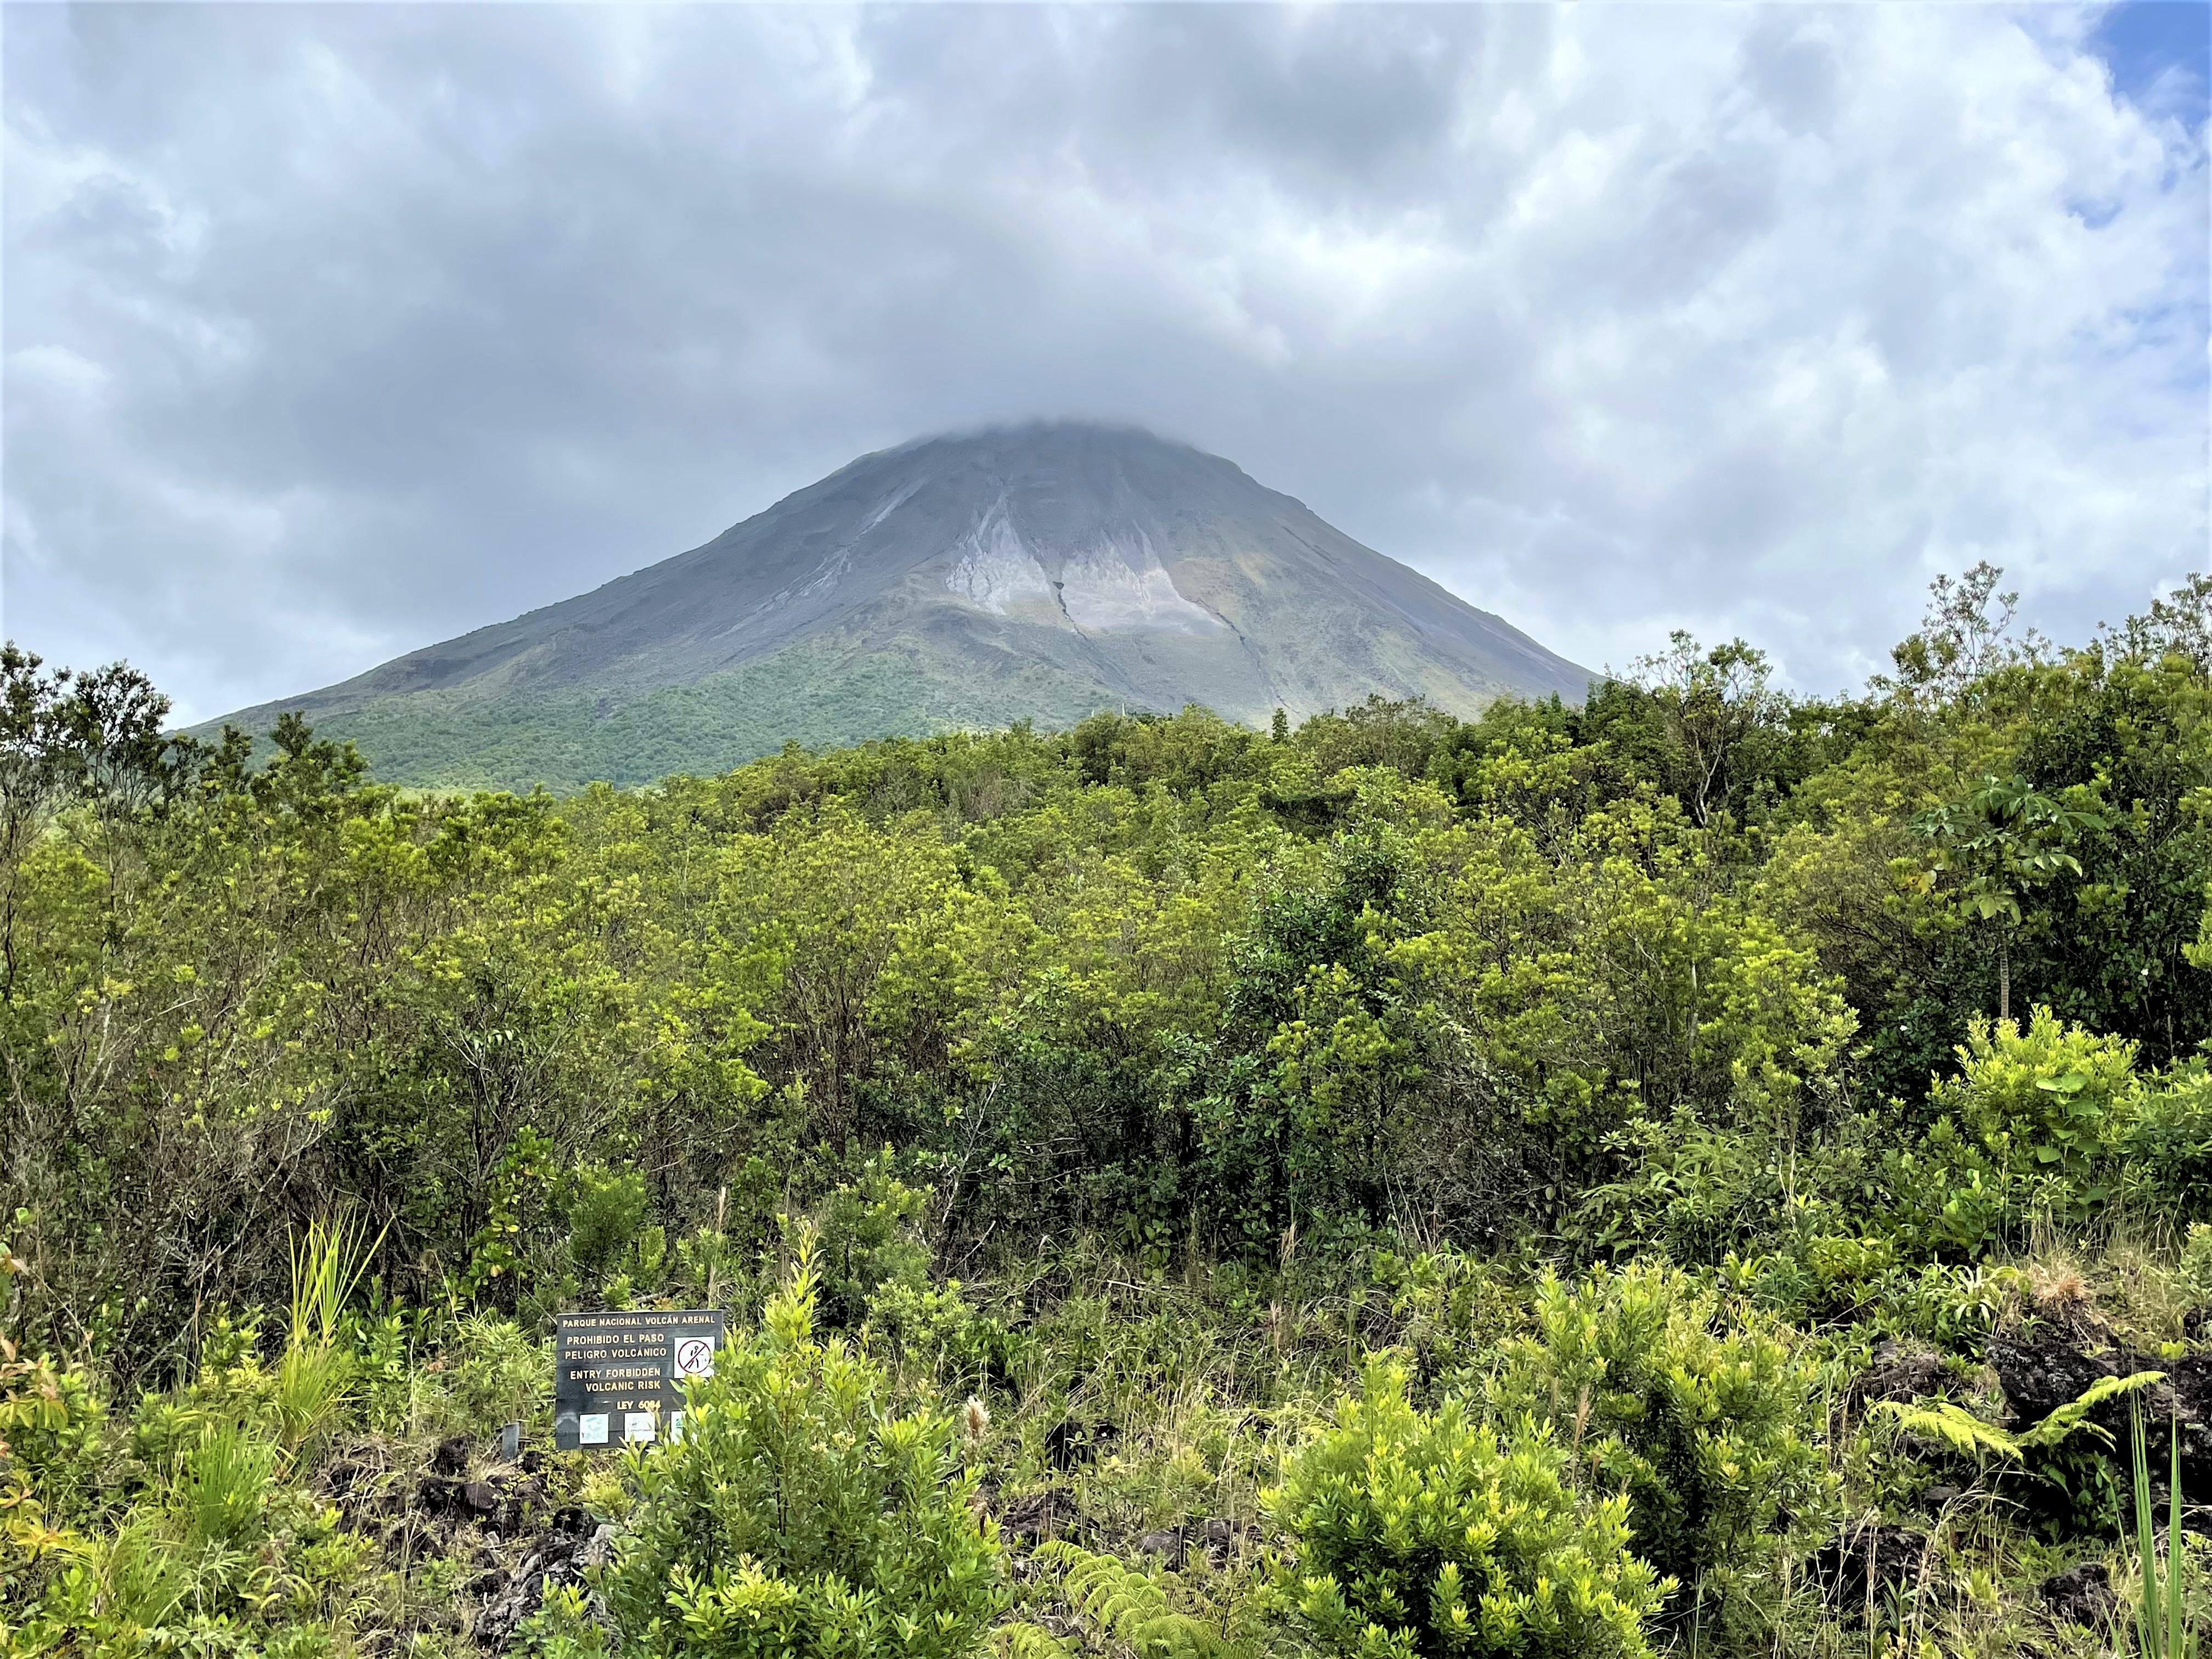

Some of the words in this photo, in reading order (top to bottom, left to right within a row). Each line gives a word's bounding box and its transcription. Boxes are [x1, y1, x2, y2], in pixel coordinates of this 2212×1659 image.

[563, 1319, 596, 1327] PARQUE
[600, 1318, 641, 1326] NACIONAL
[645, 1315, 678, 1325] VOLCÁN
[567, 1335, 619, 1345] PROHIBIDO
[623, 1334, 635, 1343] EL
[639, 1334, 664, 1342] PASO
[565, 1350, 607, 1359] PELIGRO
[612, 1347, 667, 1358] VOLCÁNICO
[571, 1370, 601, 1379] ENTRY
[606, 1368, 661, 1378] FORBIDDEN
[586, 1381, 634, 1392] VOLCANIC
[637, 1380, 661, 1390] RISK
[617, 1401, 634, 1410] LEY
